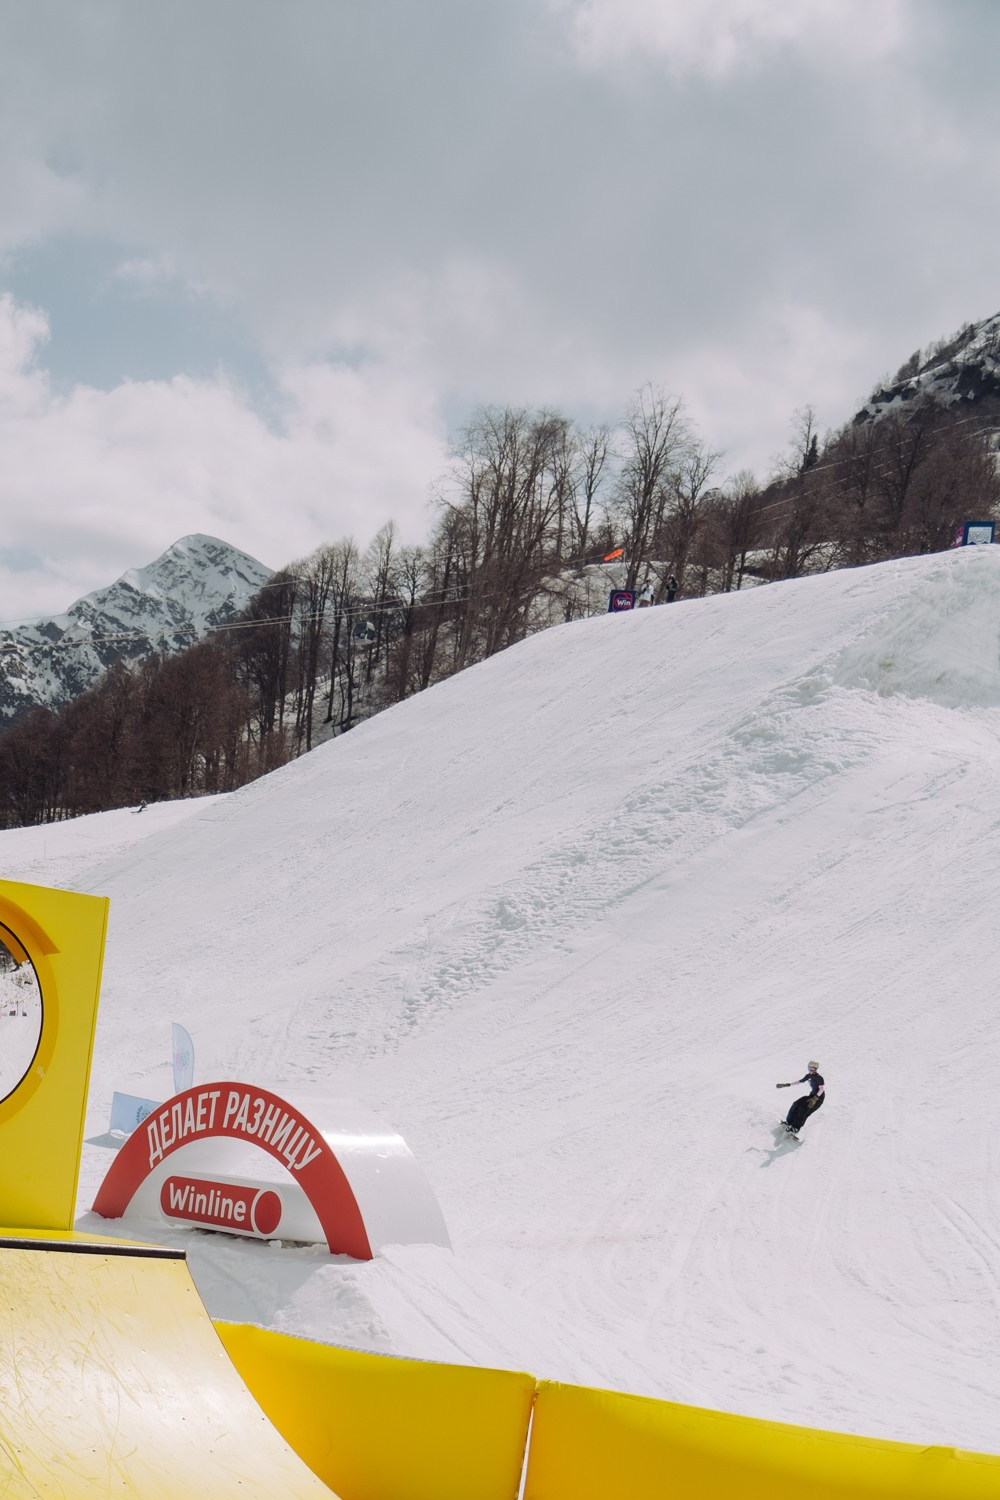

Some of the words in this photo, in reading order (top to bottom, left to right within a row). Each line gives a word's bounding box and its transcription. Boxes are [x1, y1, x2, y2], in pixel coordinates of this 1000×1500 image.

[147, 1090, 221, 1169] ДЕЛАЕТ
[223, 1091, 323, 1171] РАЗНИЦУ
[169, 1182, 246, 1222] Winline
